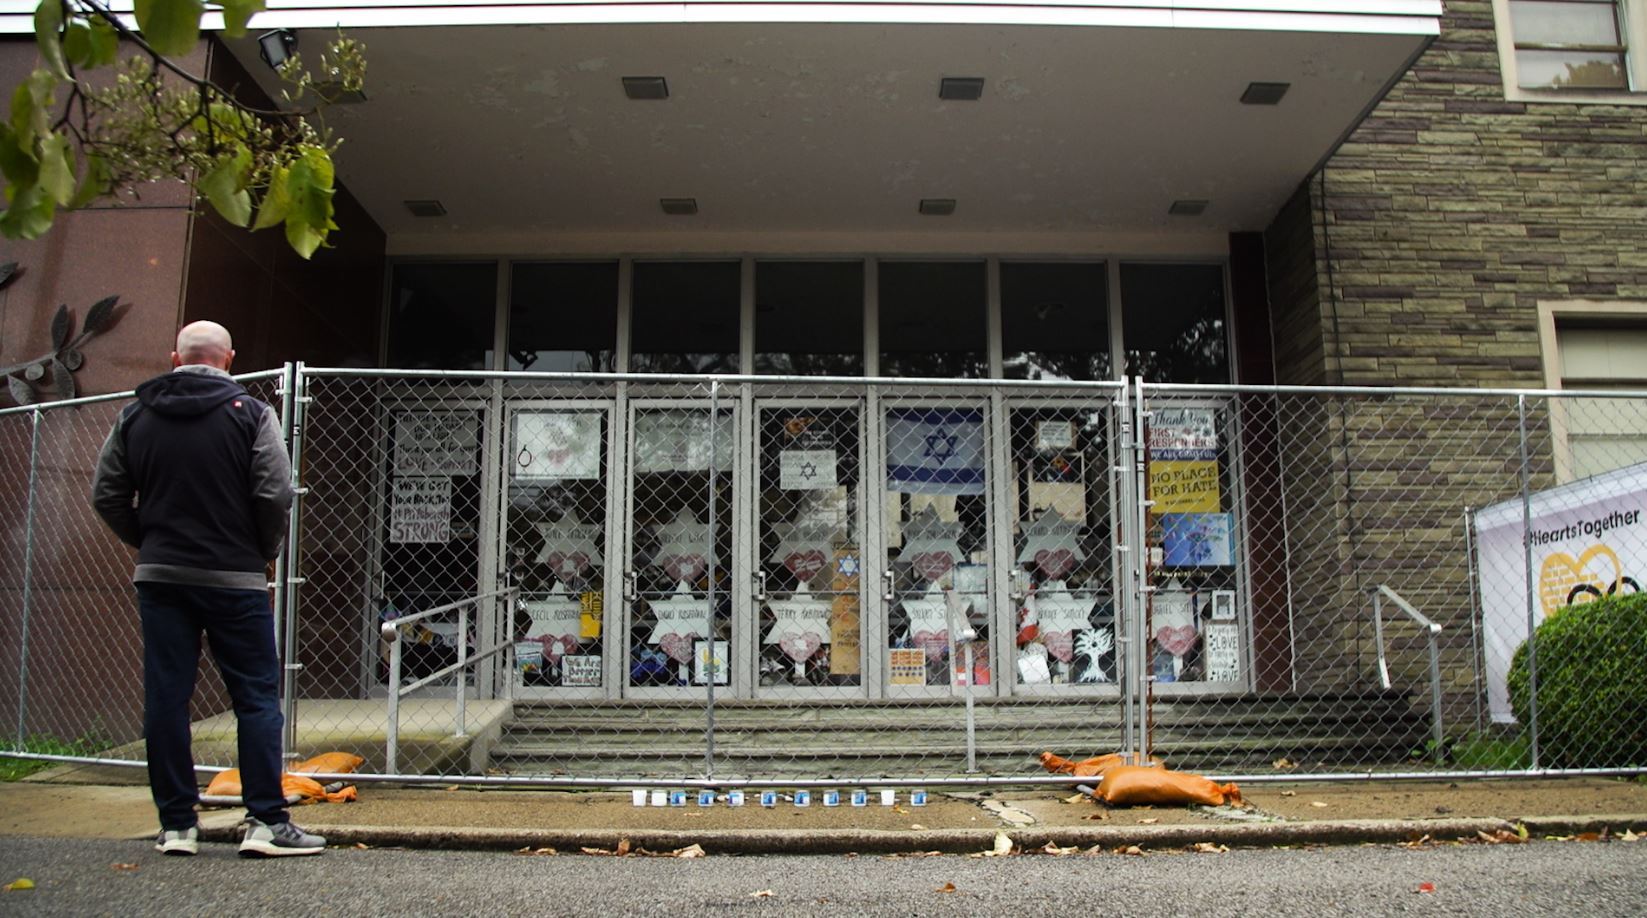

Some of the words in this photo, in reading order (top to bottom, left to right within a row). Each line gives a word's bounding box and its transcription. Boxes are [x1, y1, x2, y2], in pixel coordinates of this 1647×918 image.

[1152, 407, 1185, 426] Thank
[1190, 411, 1208, 426] You
[1150, 428, 1175, 438] FIRST
[1151, 472, 1170, 483] NO
[1174, 467, 1216, 481] PLACE
[1153, 484, 1178, 497] FOR
[1182, 480, 1217, 493] HATE
[393, 521, 450, 541] STRONG
[1216, 636, 1238, 650] LOVE
